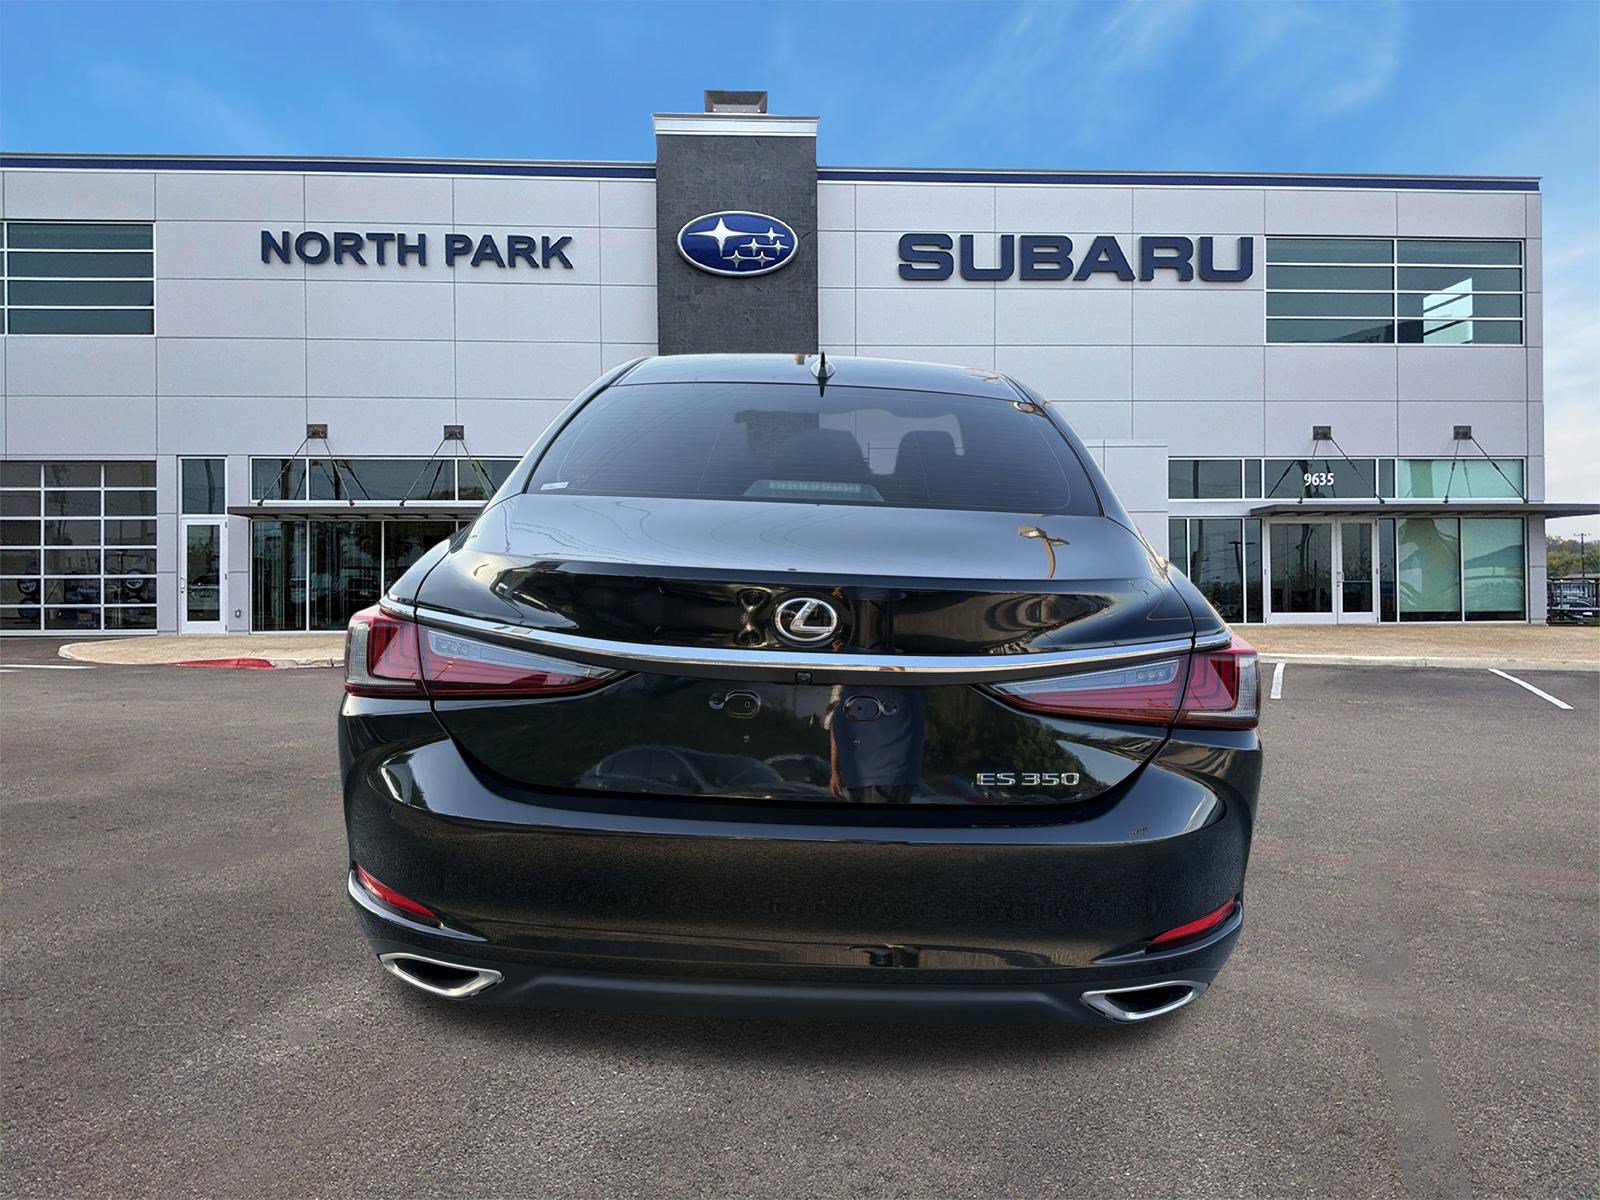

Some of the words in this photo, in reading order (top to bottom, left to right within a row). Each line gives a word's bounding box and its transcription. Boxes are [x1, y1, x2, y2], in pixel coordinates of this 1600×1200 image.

[260, 230, 427, 267] NORTH
[444, 233, 574, 270] PARK
[898, 233, 1254, 283] SUBARU
[1303, 472, 1335, 487] 9635
[976, 772, 1016, 786] ES
[1021, 772, 1080, 786] 350
